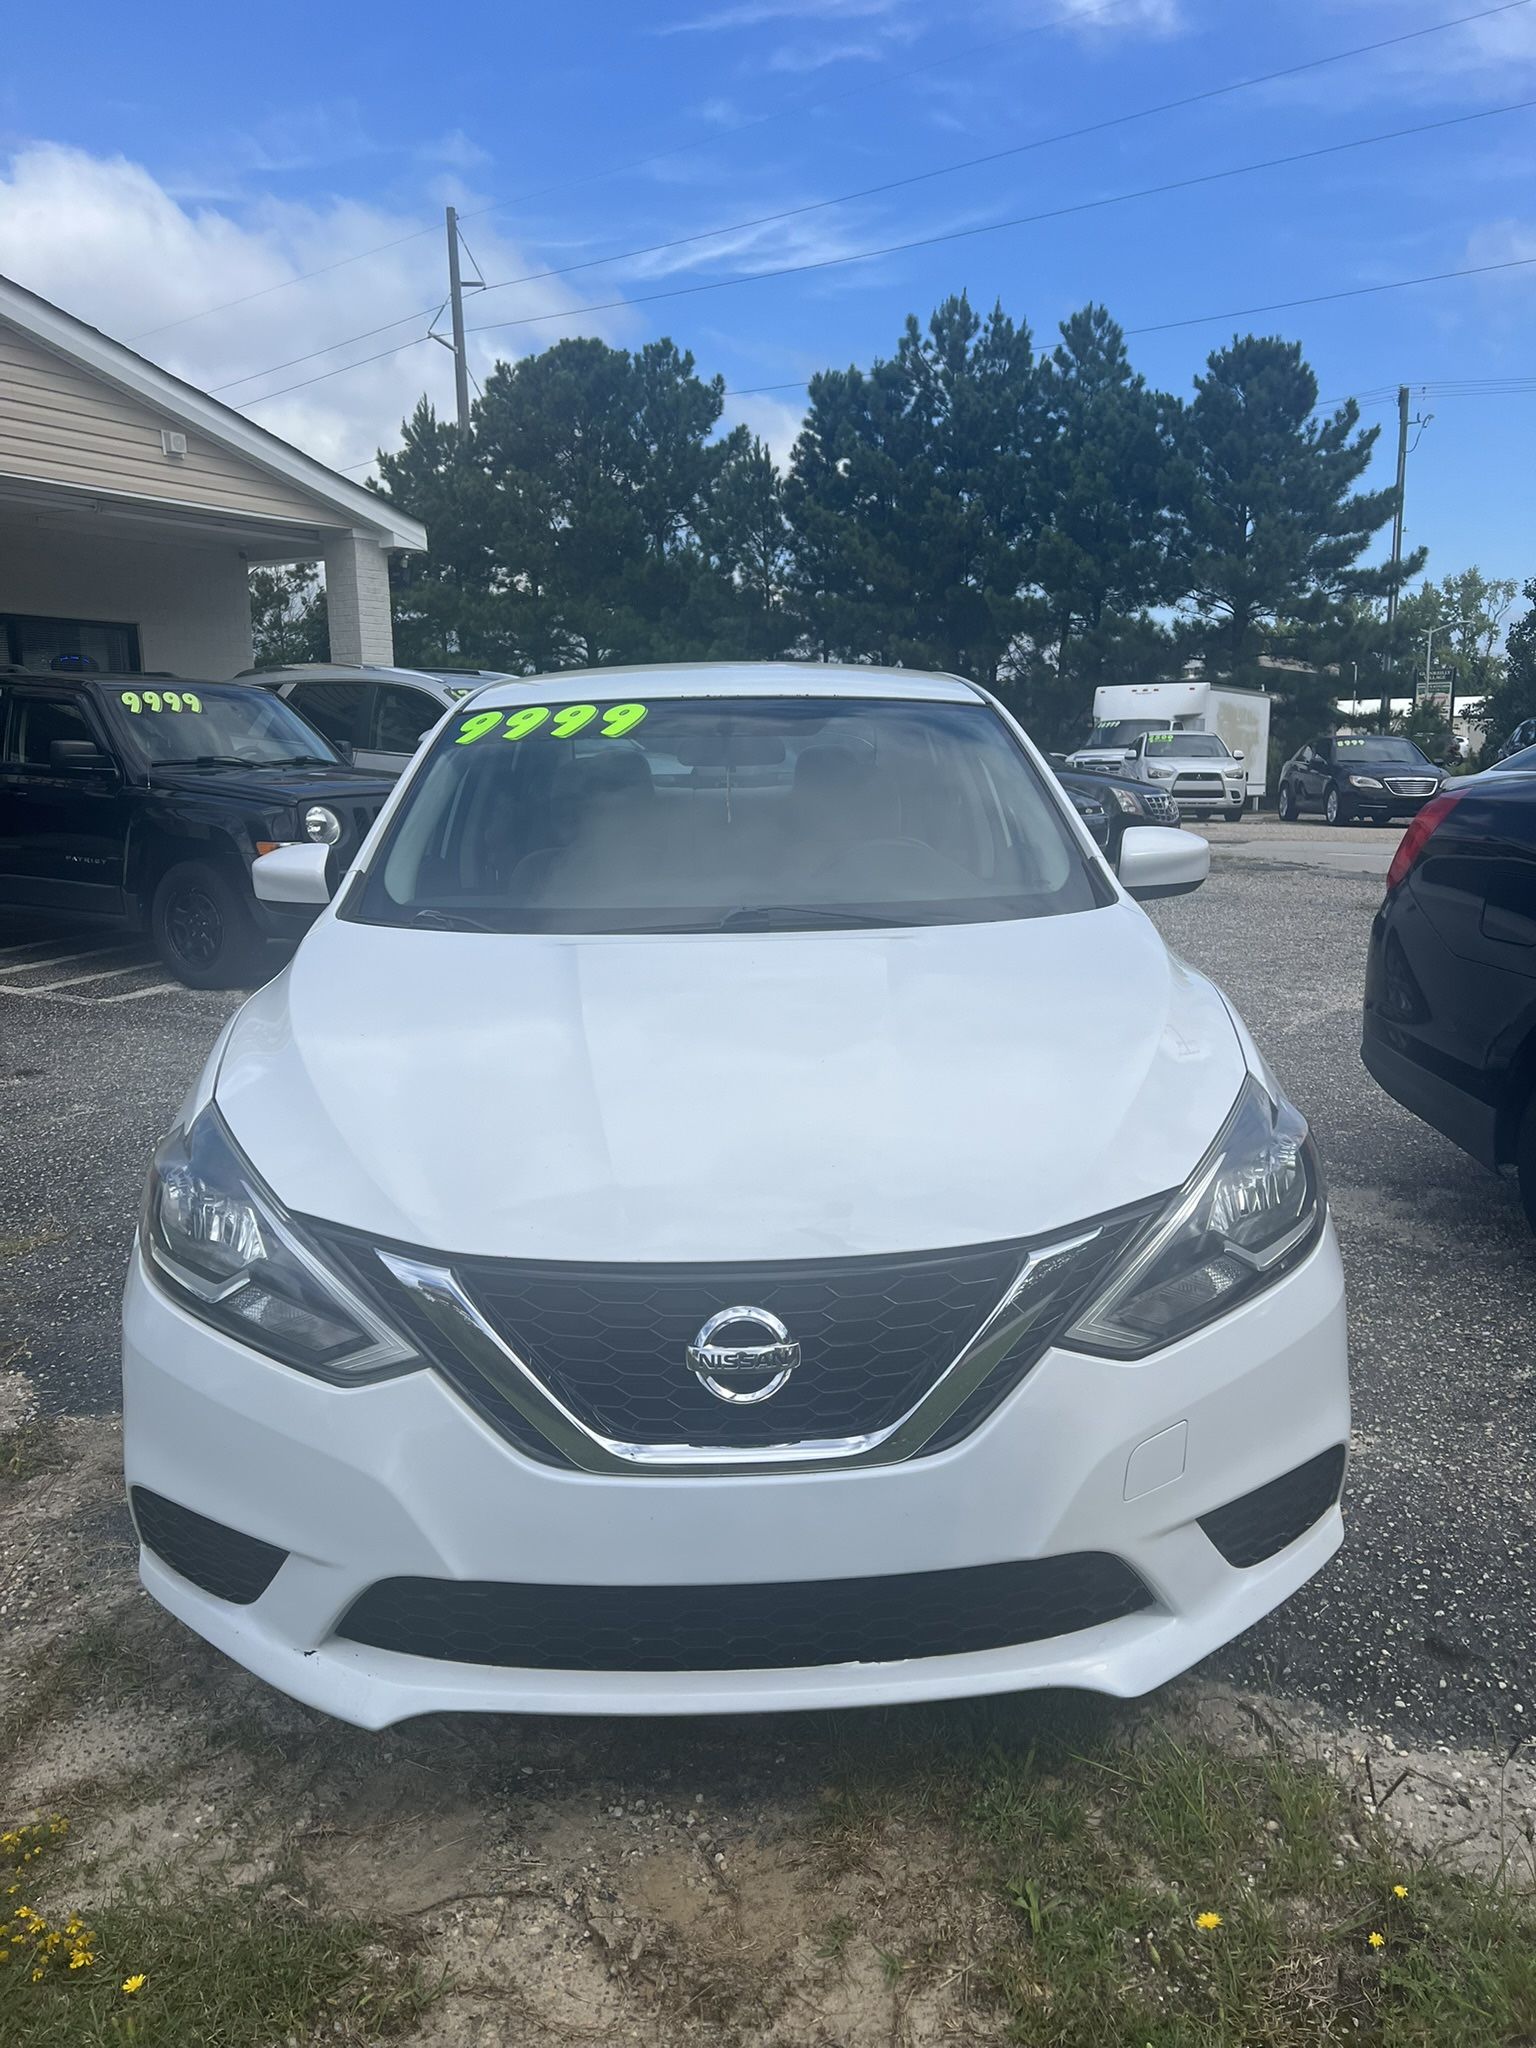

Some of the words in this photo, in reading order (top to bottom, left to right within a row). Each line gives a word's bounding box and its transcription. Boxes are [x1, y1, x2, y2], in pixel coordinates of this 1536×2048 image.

[121, 691, 202, 714] 9999
[455, 703, 648, 745] 9999
[65, 855, 107, 865] PATRIOT
[699, 1349, 794, 1369] NISSAN
